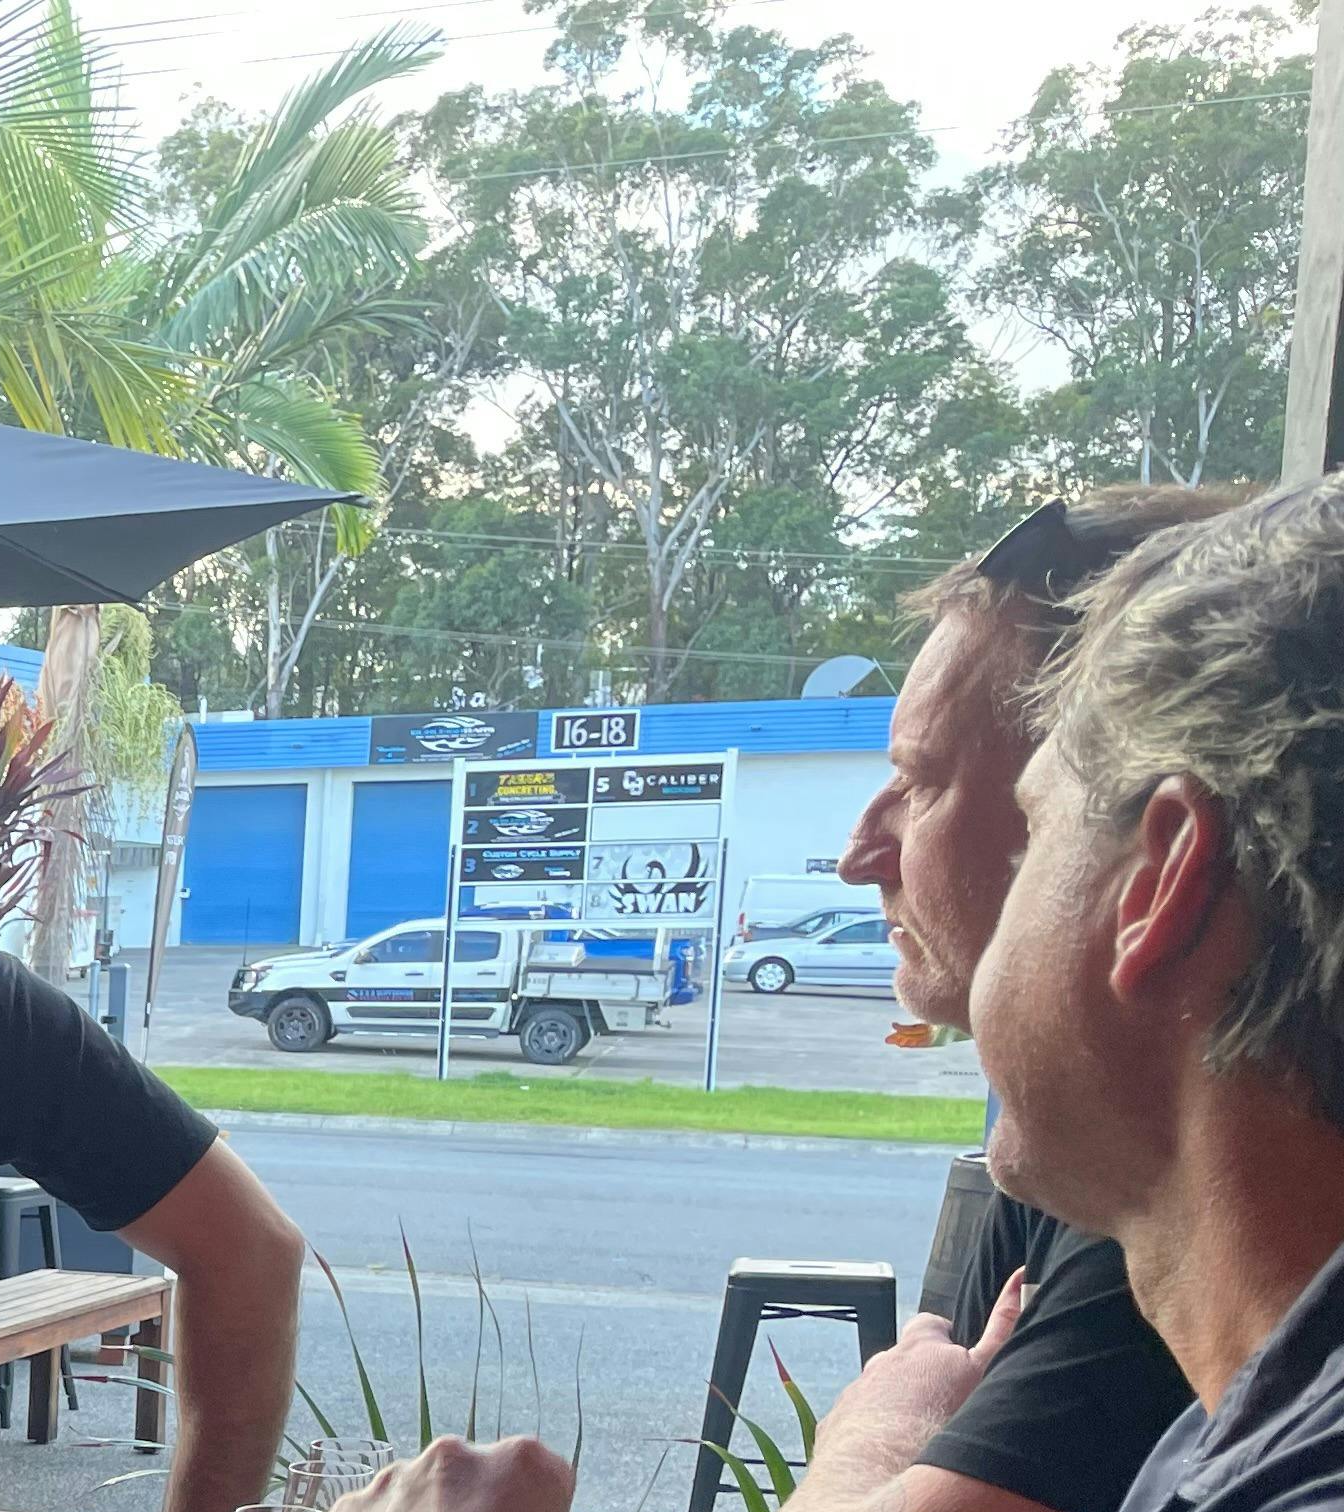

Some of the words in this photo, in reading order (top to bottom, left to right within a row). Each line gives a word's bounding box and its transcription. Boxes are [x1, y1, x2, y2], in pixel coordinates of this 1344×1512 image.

[562, 717, 627, 747] 16-18
[596, 776, 610, 793] 5
[646, 773, 719, 786] CALIBER
[466, 820, 479, 834] 2
[464, 858, 477, 873] 3
[592, 856, 604, 870] 7
[621, 891, 697, 914] SWAN
